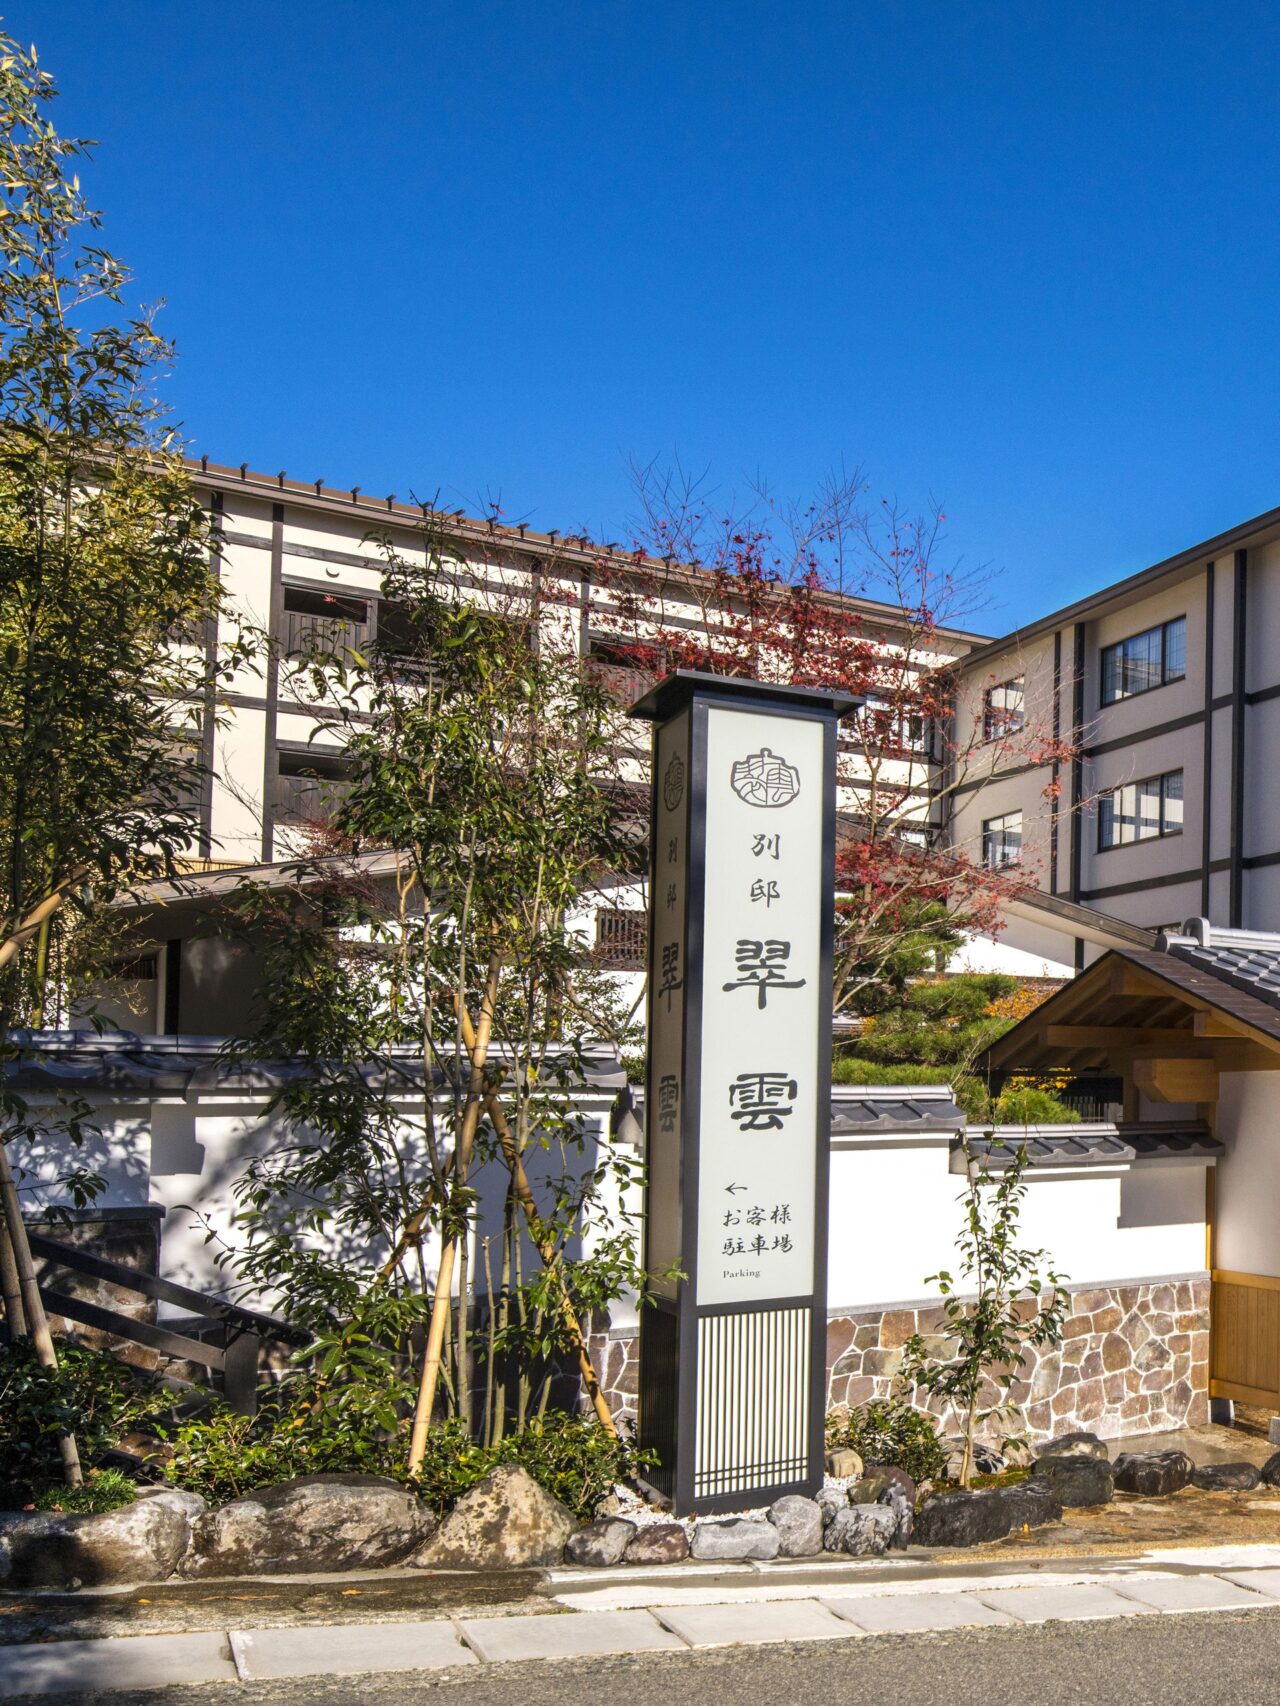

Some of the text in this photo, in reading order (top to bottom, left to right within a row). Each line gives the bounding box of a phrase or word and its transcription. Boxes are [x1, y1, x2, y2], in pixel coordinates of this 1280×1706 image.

[722, 1204, 792, 1227] お客様
[722, 1233, 793, 1256] 駐車場
[723, 1268, 761, 1279] Parking
